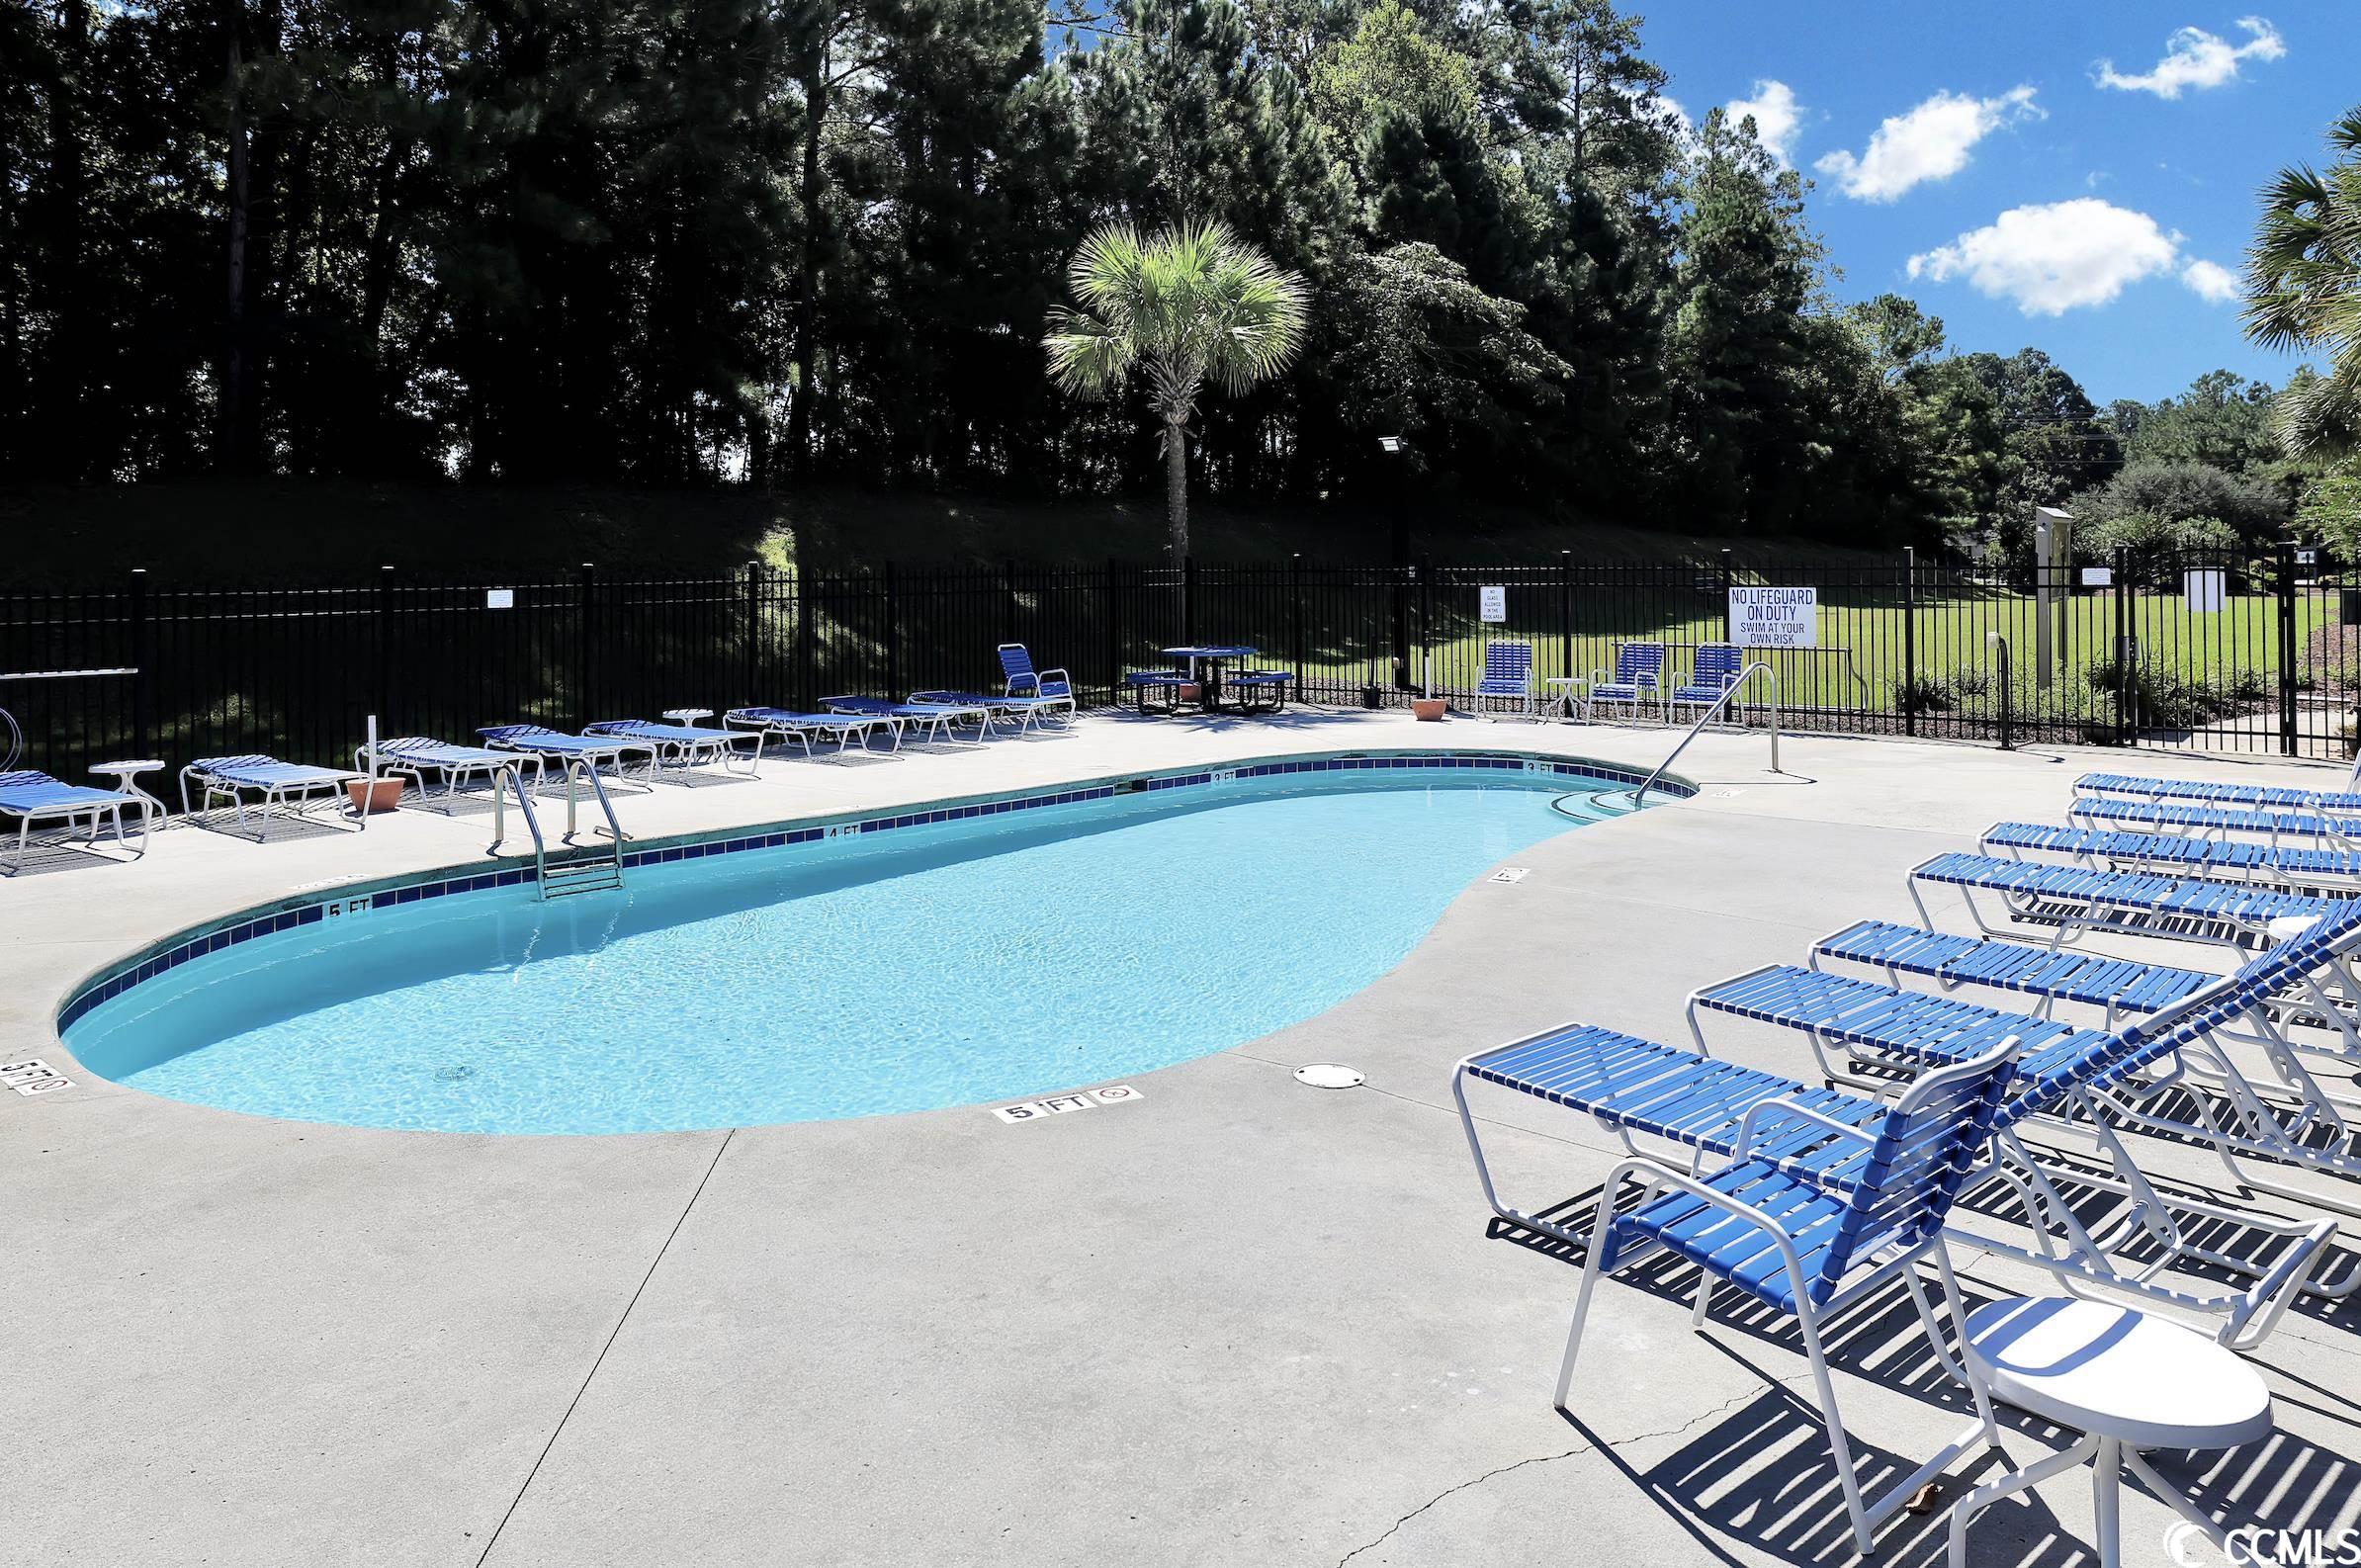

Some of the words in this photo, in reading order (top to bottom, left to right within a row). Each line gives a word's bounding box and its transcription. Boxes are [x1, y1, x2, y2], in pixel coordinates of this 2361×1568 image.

[1732, 589, 1747, 604] NO
[1750, 589, 1813, 605] LIFEGUARD
[1747, 605, 1763, 621] ON
[1766, 605, 1796, 621] DUTY
[1740, 622, 1766, 634] SWIM
[1768, 623, 1779, 634] AT
[1781, 623, 1804, 634] YOUR
[1750, 634, 1771, 644] OWN
[1774, 634, 1794, 645] RISK
[843, 825, 858, 836] FT
[328, 903, 340, 916] 5
[349, 898, 370, 914] FT
[1006, 1106, 1033, 1119] 5
[1046, 1095, 1085, 1111] FT
